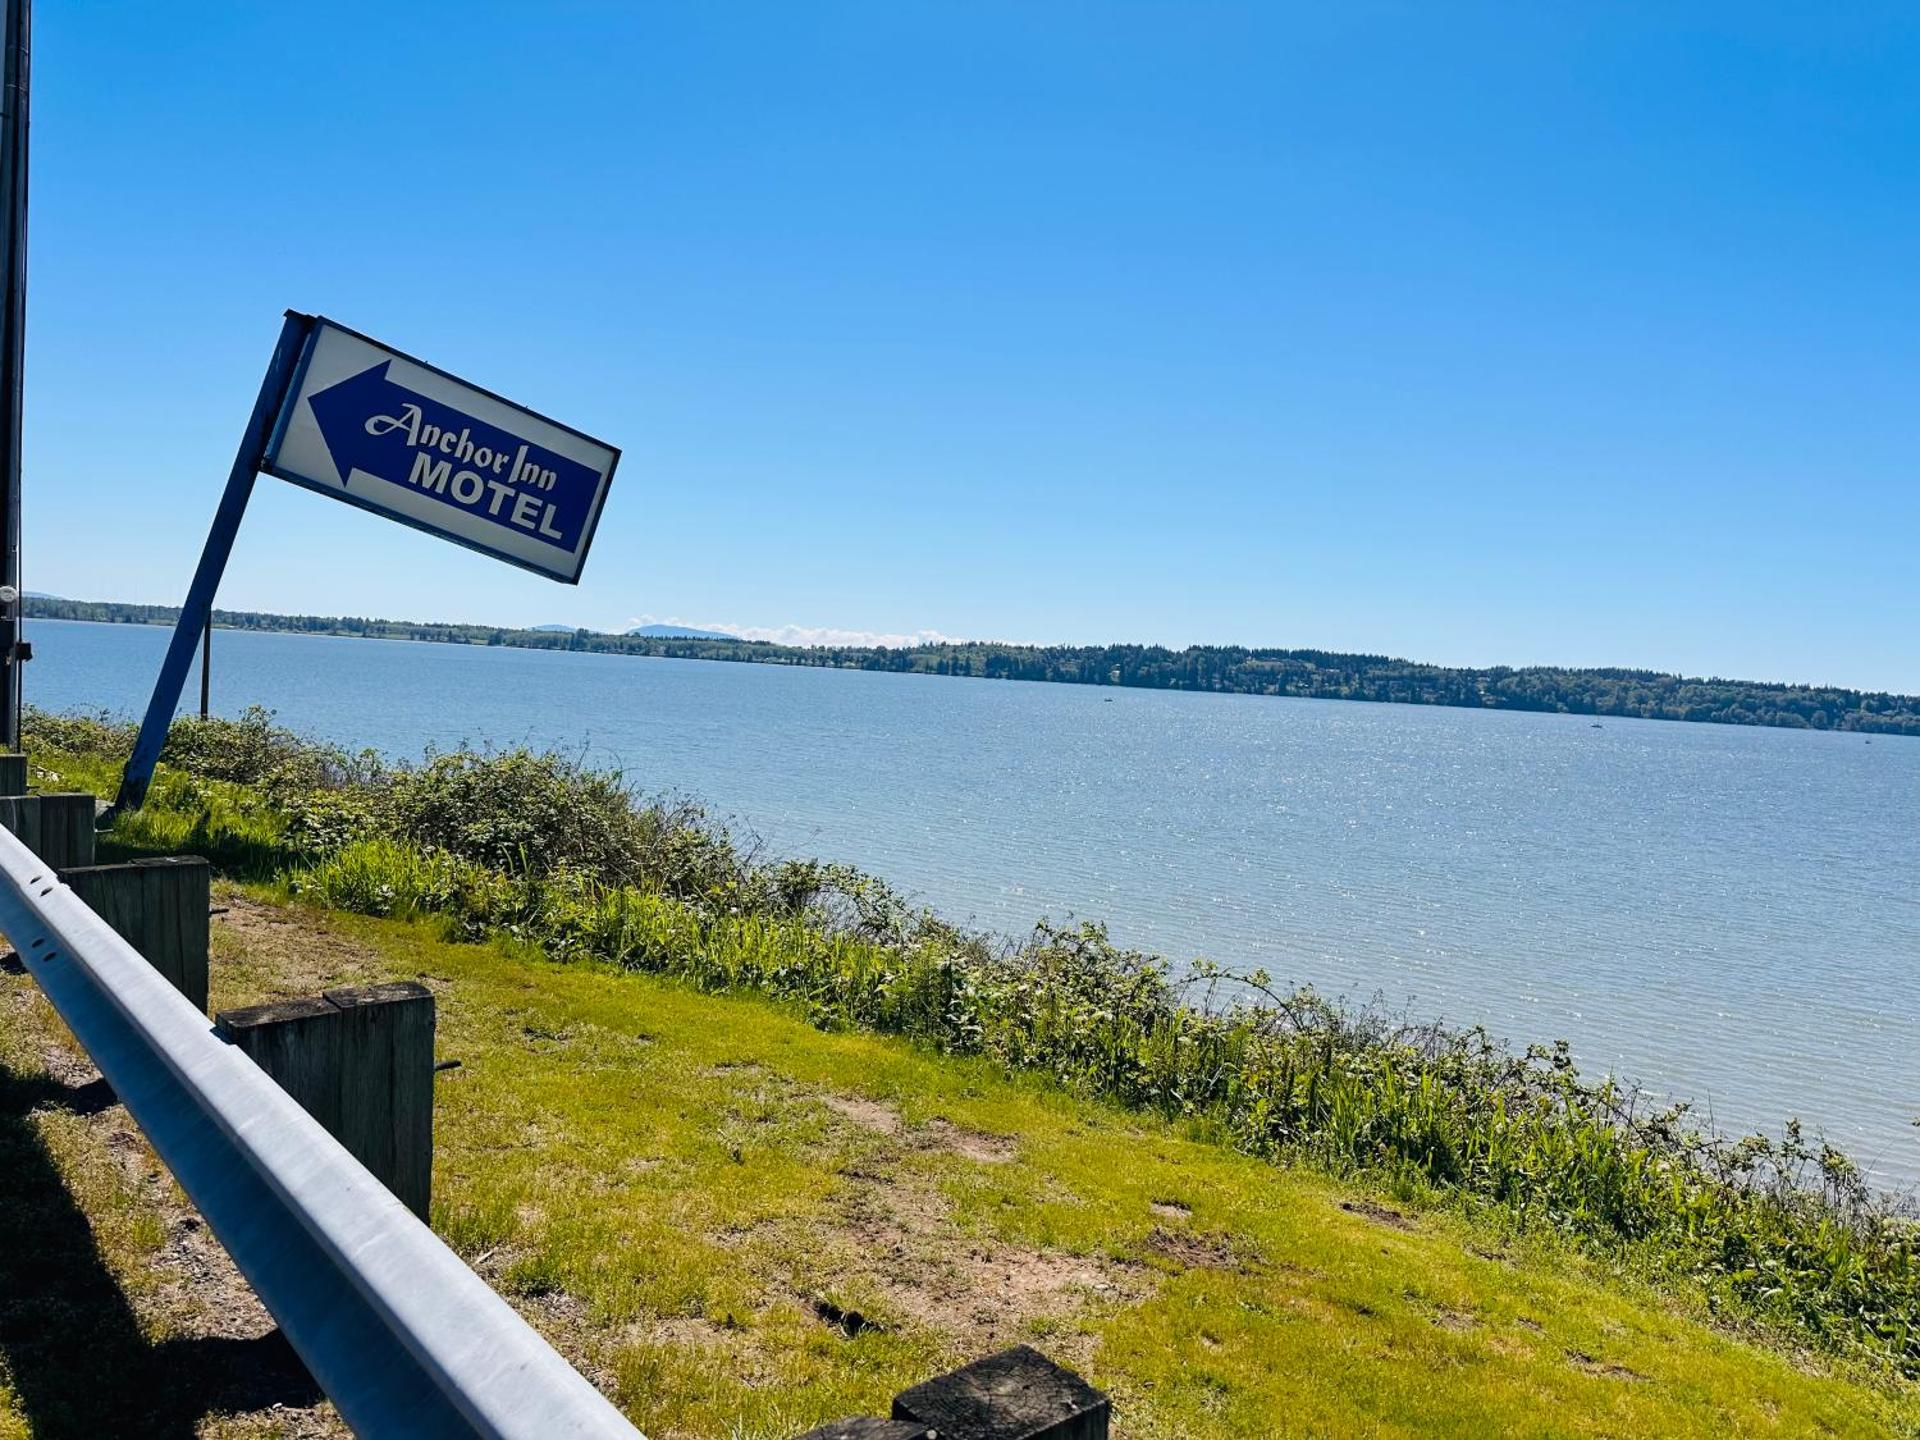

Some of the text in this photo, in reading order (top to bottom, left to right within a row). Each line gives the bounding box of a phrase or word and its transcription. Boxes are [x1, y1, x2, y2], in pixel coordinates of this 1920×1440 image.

[365, 403, 557, 491] Anchor Inn
[408, 451, 563, 540] MOTEL
